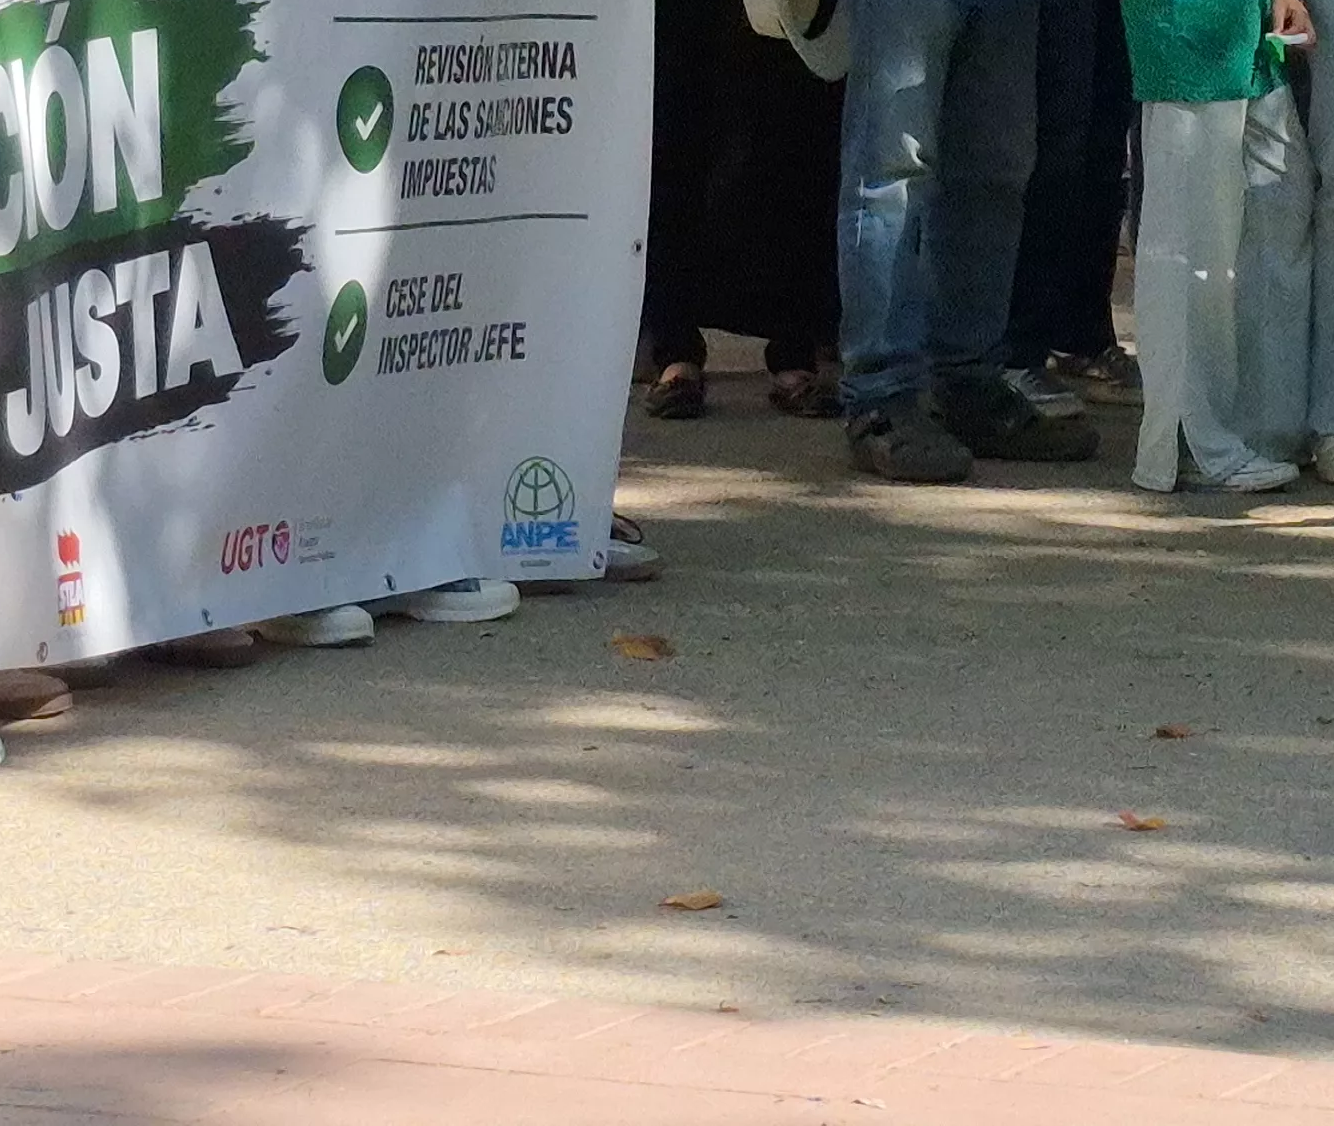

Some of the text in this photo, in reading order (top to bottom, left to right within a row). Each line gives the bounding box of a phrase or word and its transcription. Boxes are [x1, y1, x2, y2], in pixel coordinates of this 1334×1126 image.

[414, 35, 578, 86] REVISIÓN EXTERNA
[408, 96, 574, 142] DE LAS SANCIONES
[400, 155, 497, 200] IMPUESTAS
[385, 272, 464, 319] CESE DEL
[5, 241, 245, 458] JUSTA
[376, 321, 527, 375] INSPECTOR JEFE
[221, 523, 270, 575] UGT
[501, 520, 580, 548] ANPE
